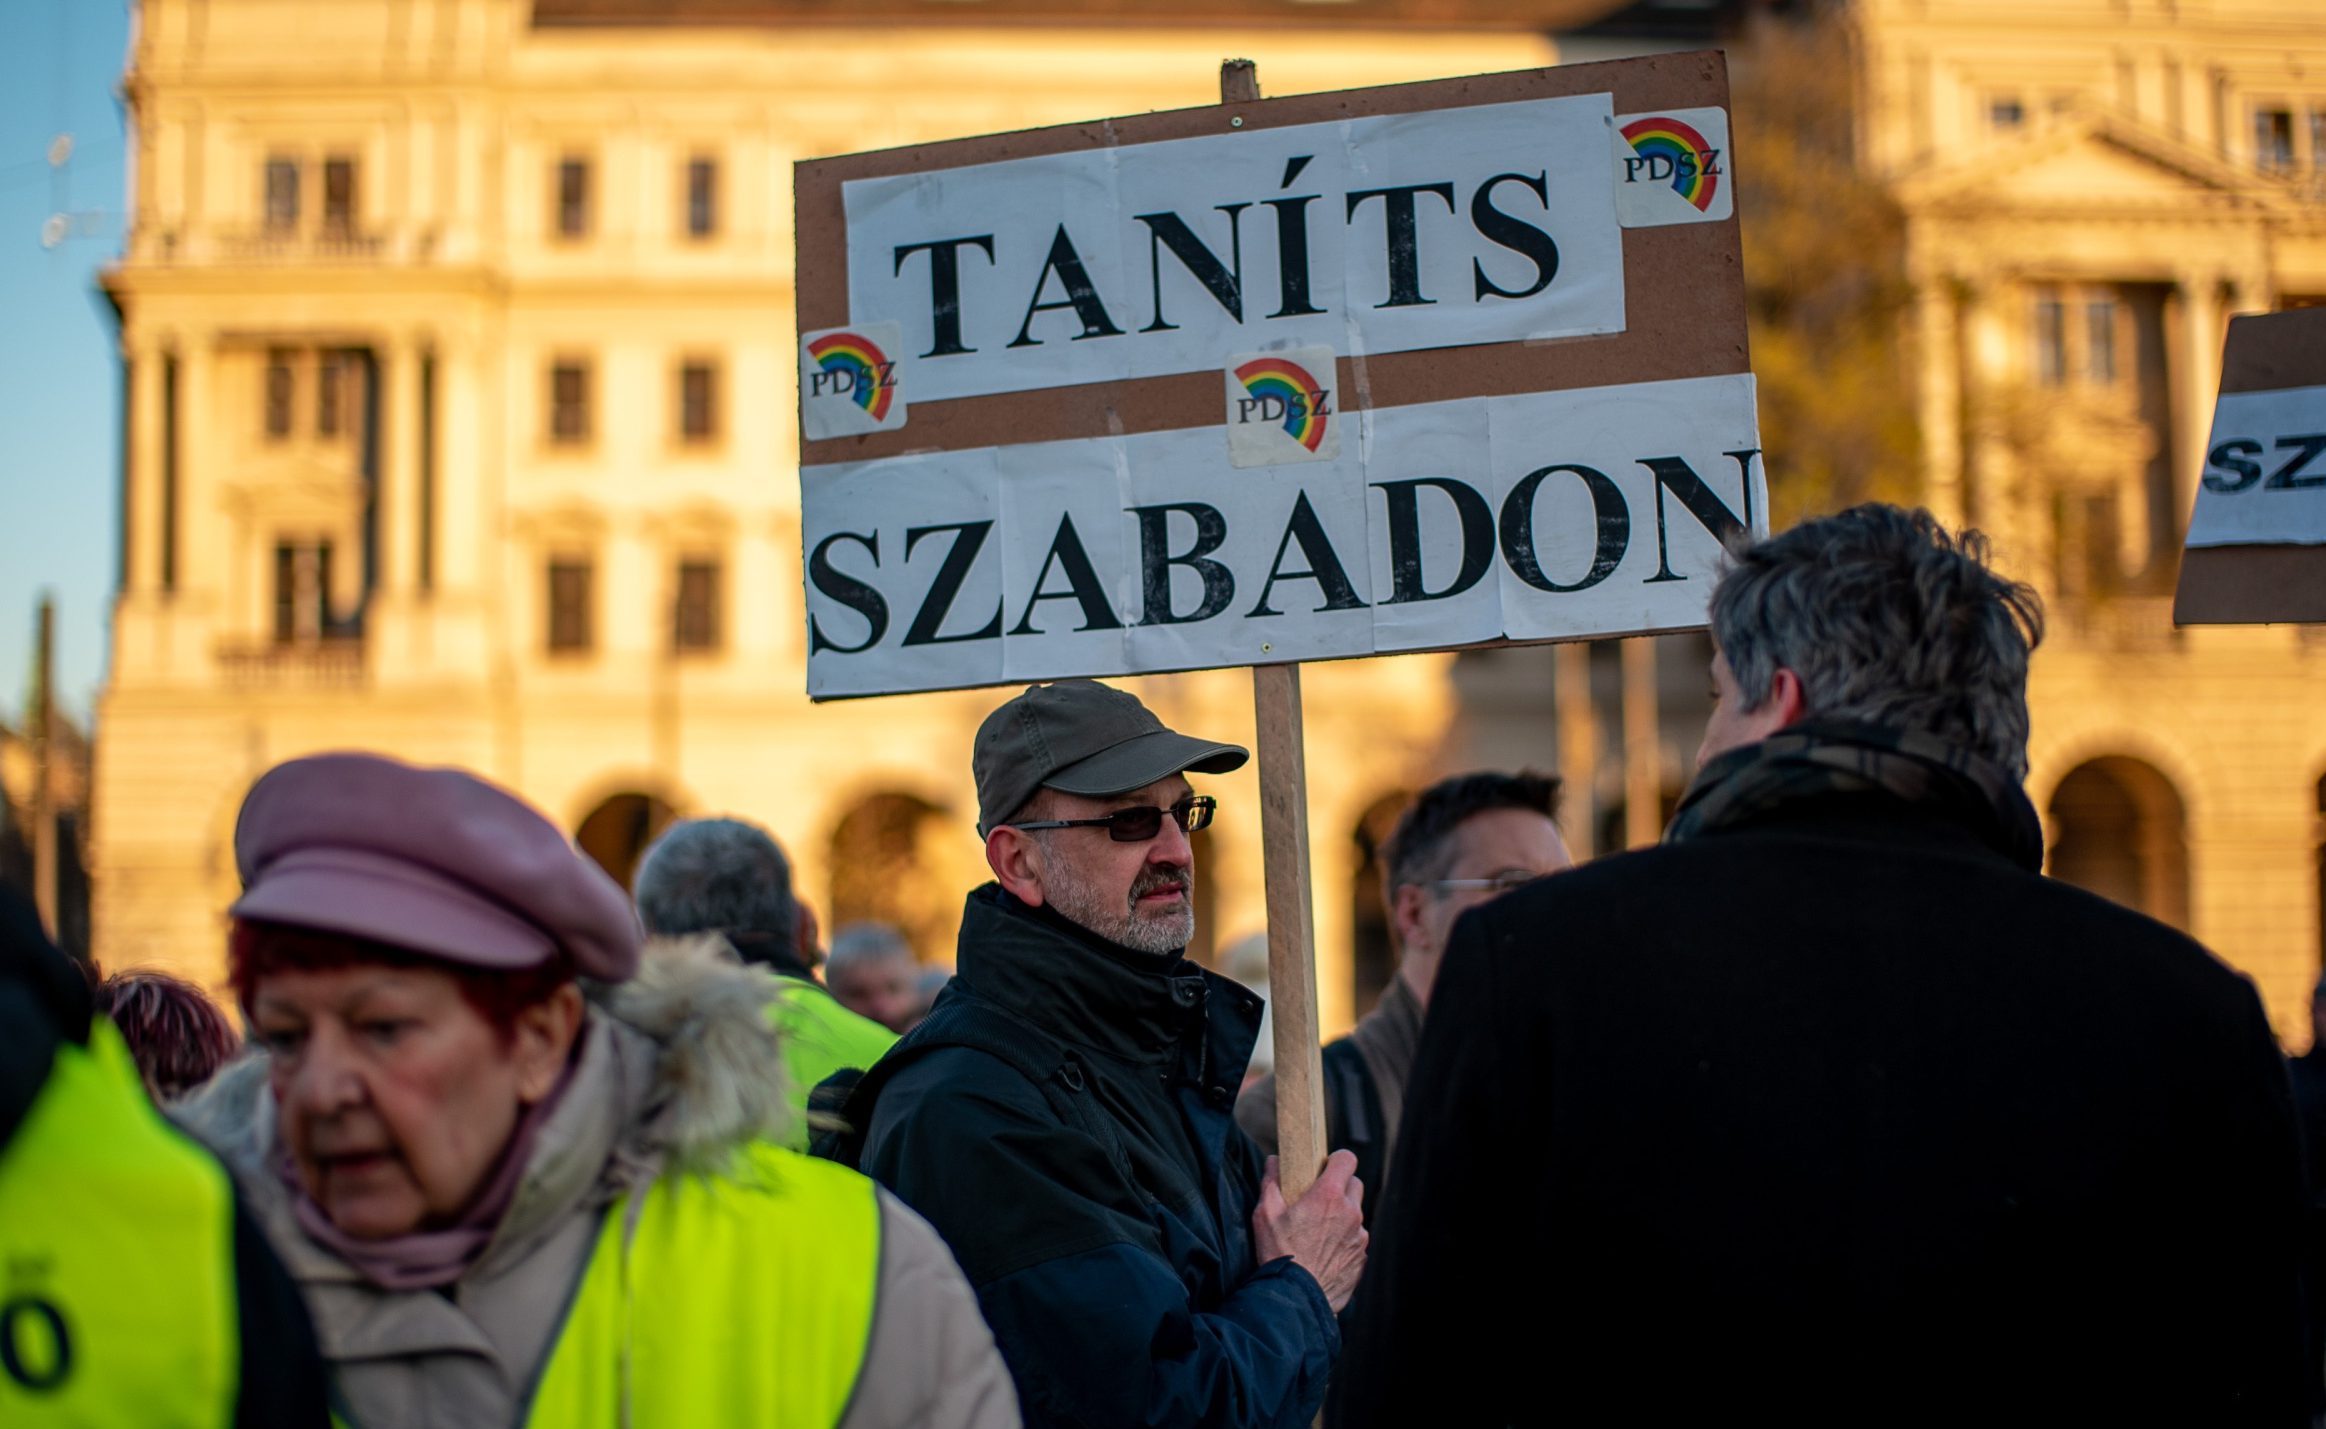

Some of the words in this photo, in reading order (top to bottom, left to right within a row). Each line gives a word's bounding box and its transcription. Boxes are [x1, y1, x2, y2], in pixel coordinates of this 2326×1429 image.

[1622, 148, 1722, 183] PDSZ
[893, 155, 1560, 359] TANÍTS
[810, 361, 898, 397] PDSZ
[1237, 389, 1332, 424] PDSZ
[808, 449, 1762, 657] SZABADON
